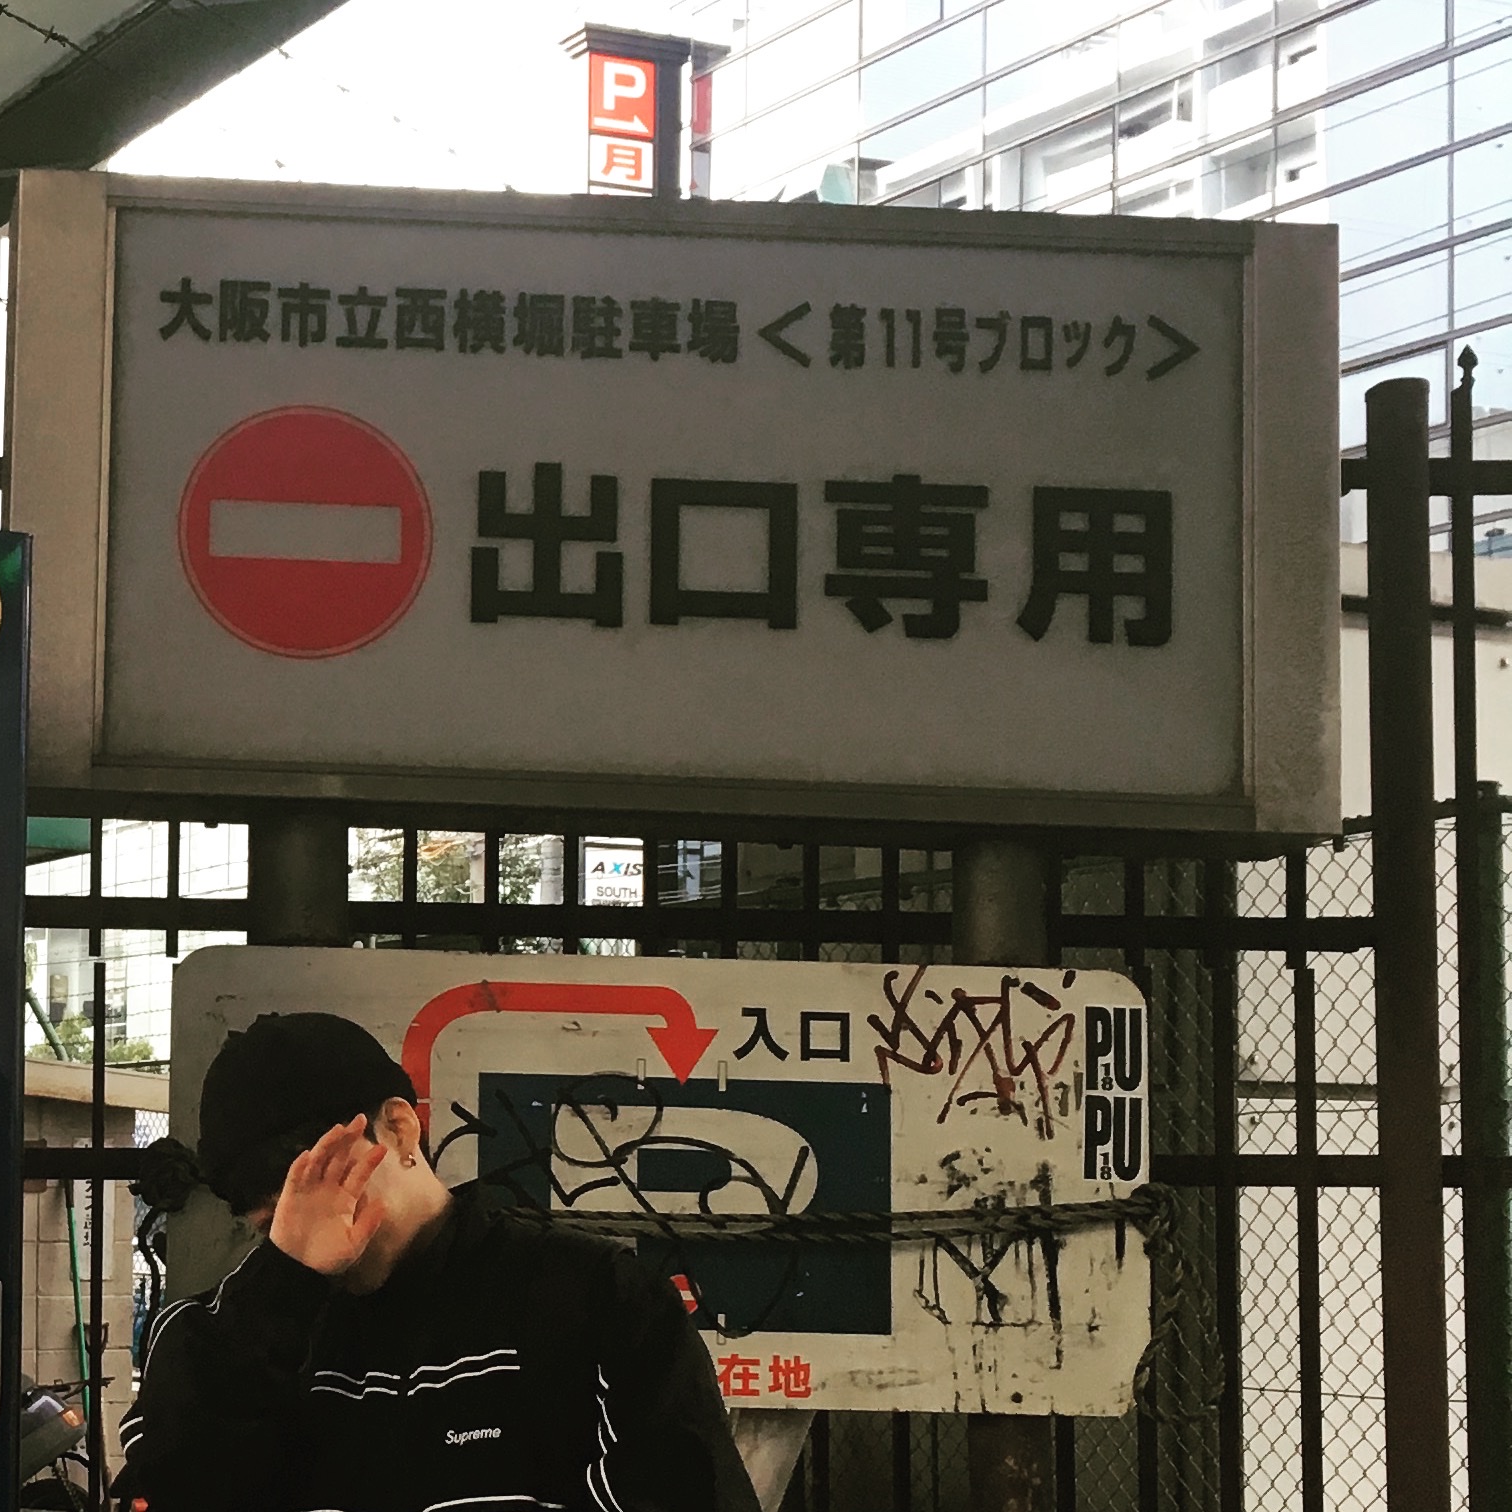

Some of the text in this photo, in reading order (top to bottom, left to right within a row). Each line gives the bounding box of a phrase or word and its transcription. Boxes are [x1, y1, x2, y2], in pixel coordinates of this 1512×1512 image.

[603, 61, 646, 110] P
[601, 143, 643, 181] 月
[471, 462, 1173, 647] 出口専用
[591, 862, 642, 877] AXIS
[596, 885, 638, 899] SOUTH
[733, 1006, 851, 1063] 入口
[444, 1426, 502, 1446] Supreme
